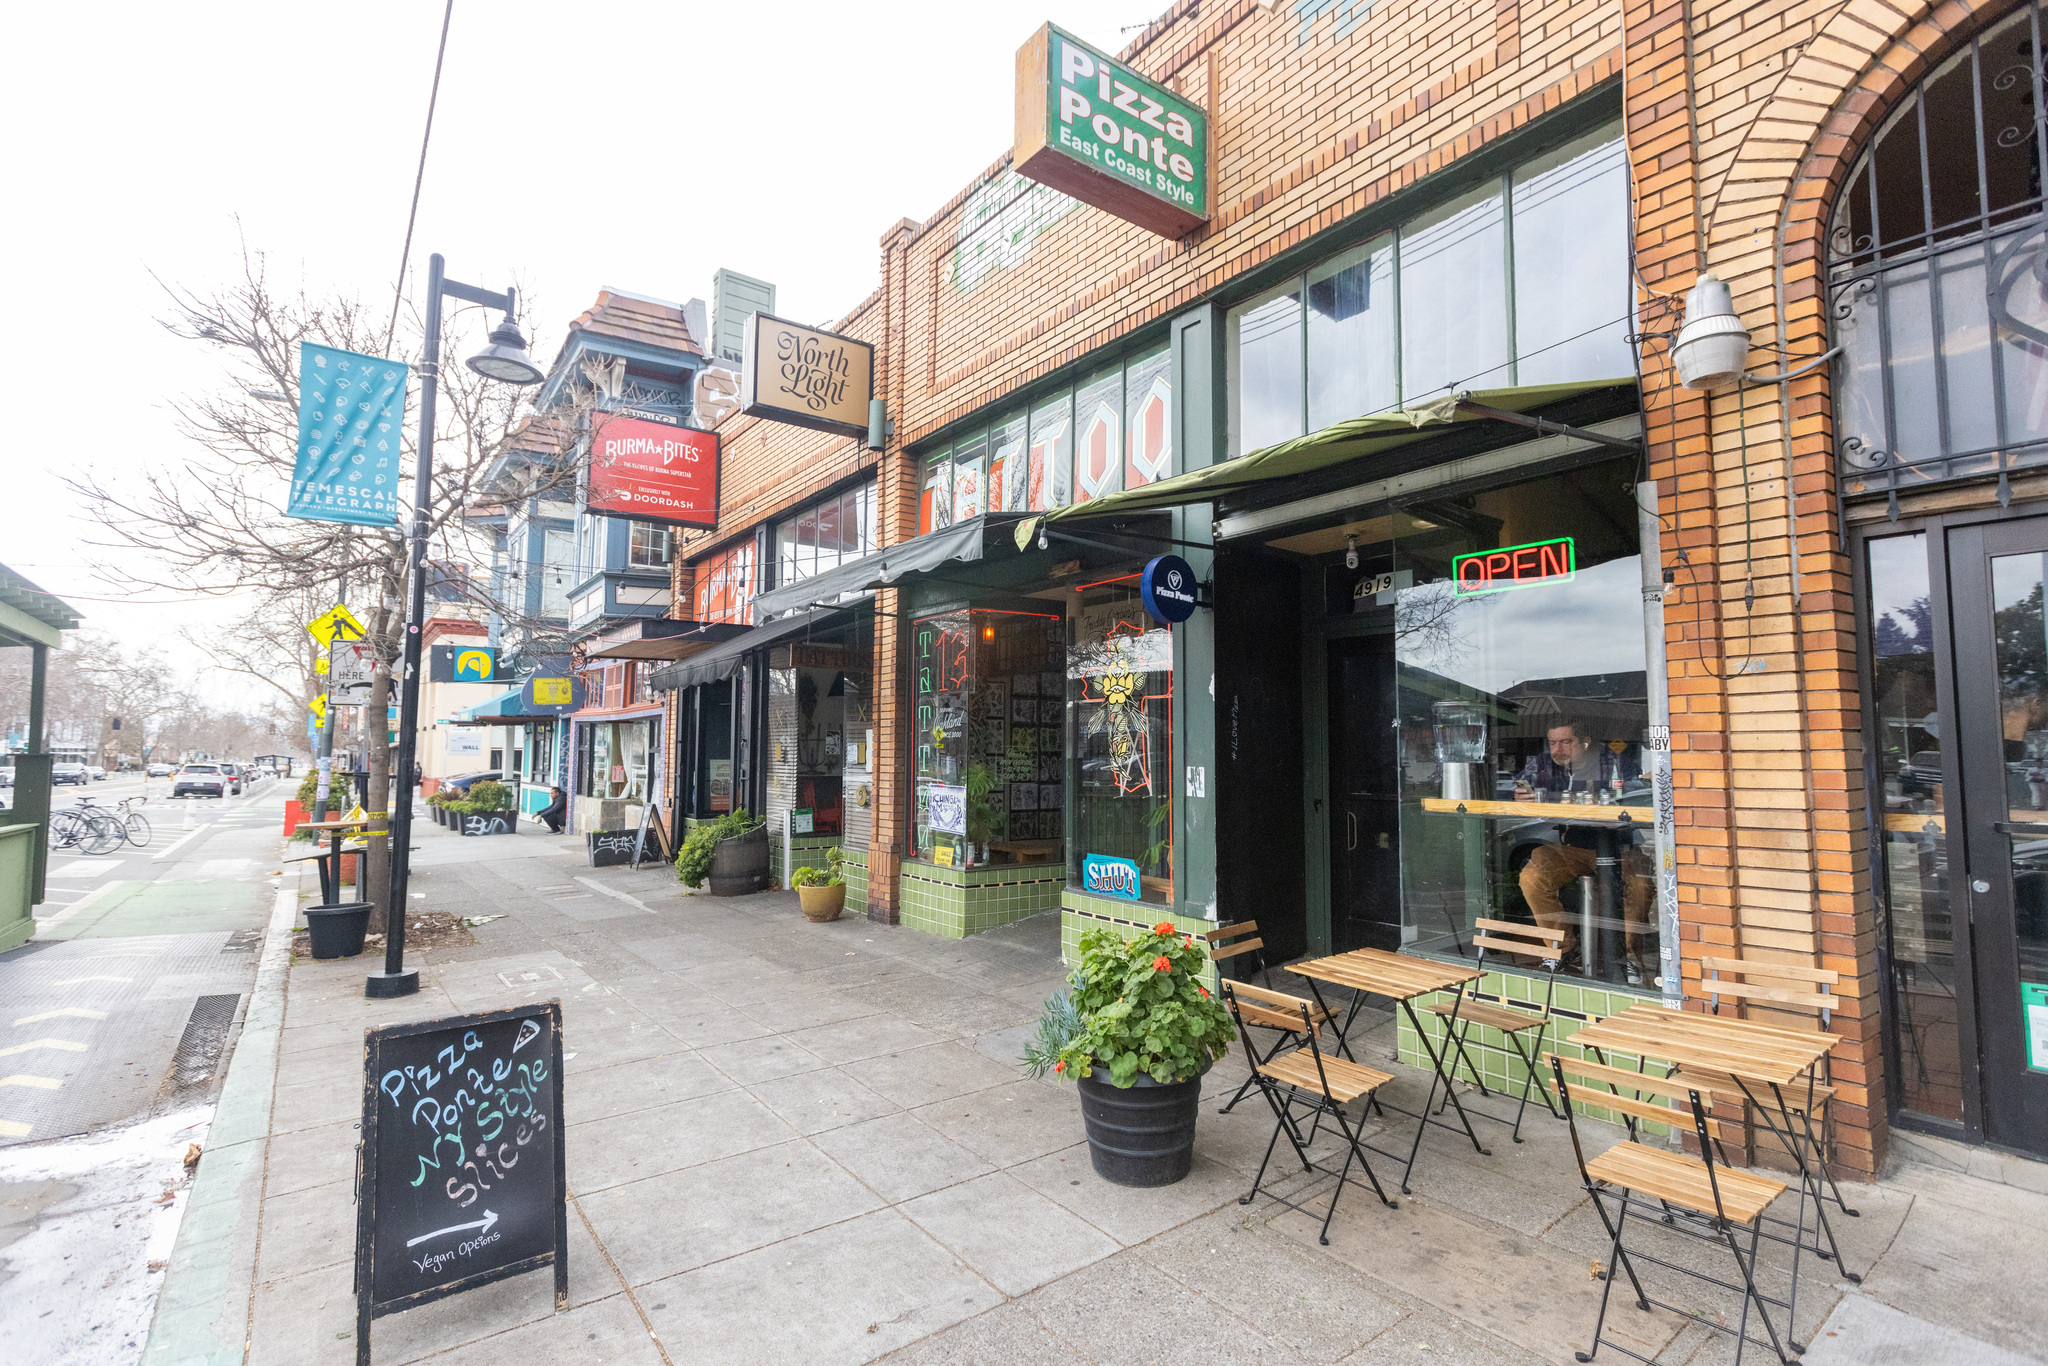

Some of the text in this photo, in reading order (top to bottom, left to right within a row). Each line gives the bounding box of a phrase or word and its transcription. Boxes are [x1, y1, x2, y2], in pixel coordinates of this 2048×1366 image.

[1060, 39, 1194, 148] Pizza
[1060, 84, 1195, 183] Ponte
[1060, 125, 1194, 205] East Coast Style
[777, 331, 850, 378] North
[780, 364, 851, 412] Light
[602, 438, 700, 468] BURMA BITES
[632, 462, 648, 471] RECIPES
[655, 466, 670, 475] BURMA
[670, 469, 692, 478] SUPERSTAR
[292, 491, 395, 512] TELEGRAPH
[294, 479, 396, 502] TEMESCAL
[323, 506, 366, 515] IMPROVEMENT
[634, 494, 694, 509] DOORDASH
[638, 486, 661, 495] EXCLUSIVELY
[1354, 575, 1392, 598] 4919
[1460, 543, 1568, 591] OPEN
[1156, 585, 1195, 603] Pizza Ponte
[338, 670, 365, 681] HERE
[935, 628, 970, 692] 13
[1088, 861, 1136, 895] SHUT
[381, 1031, 483, 1107] Pizza
[412, 1058, 513, 1134] Ponte
[476, 1059, 549, 1142] Style
[446, 1109, 547, 1208] Slices
[413, 1231, 501, 1273] Vegan Options
